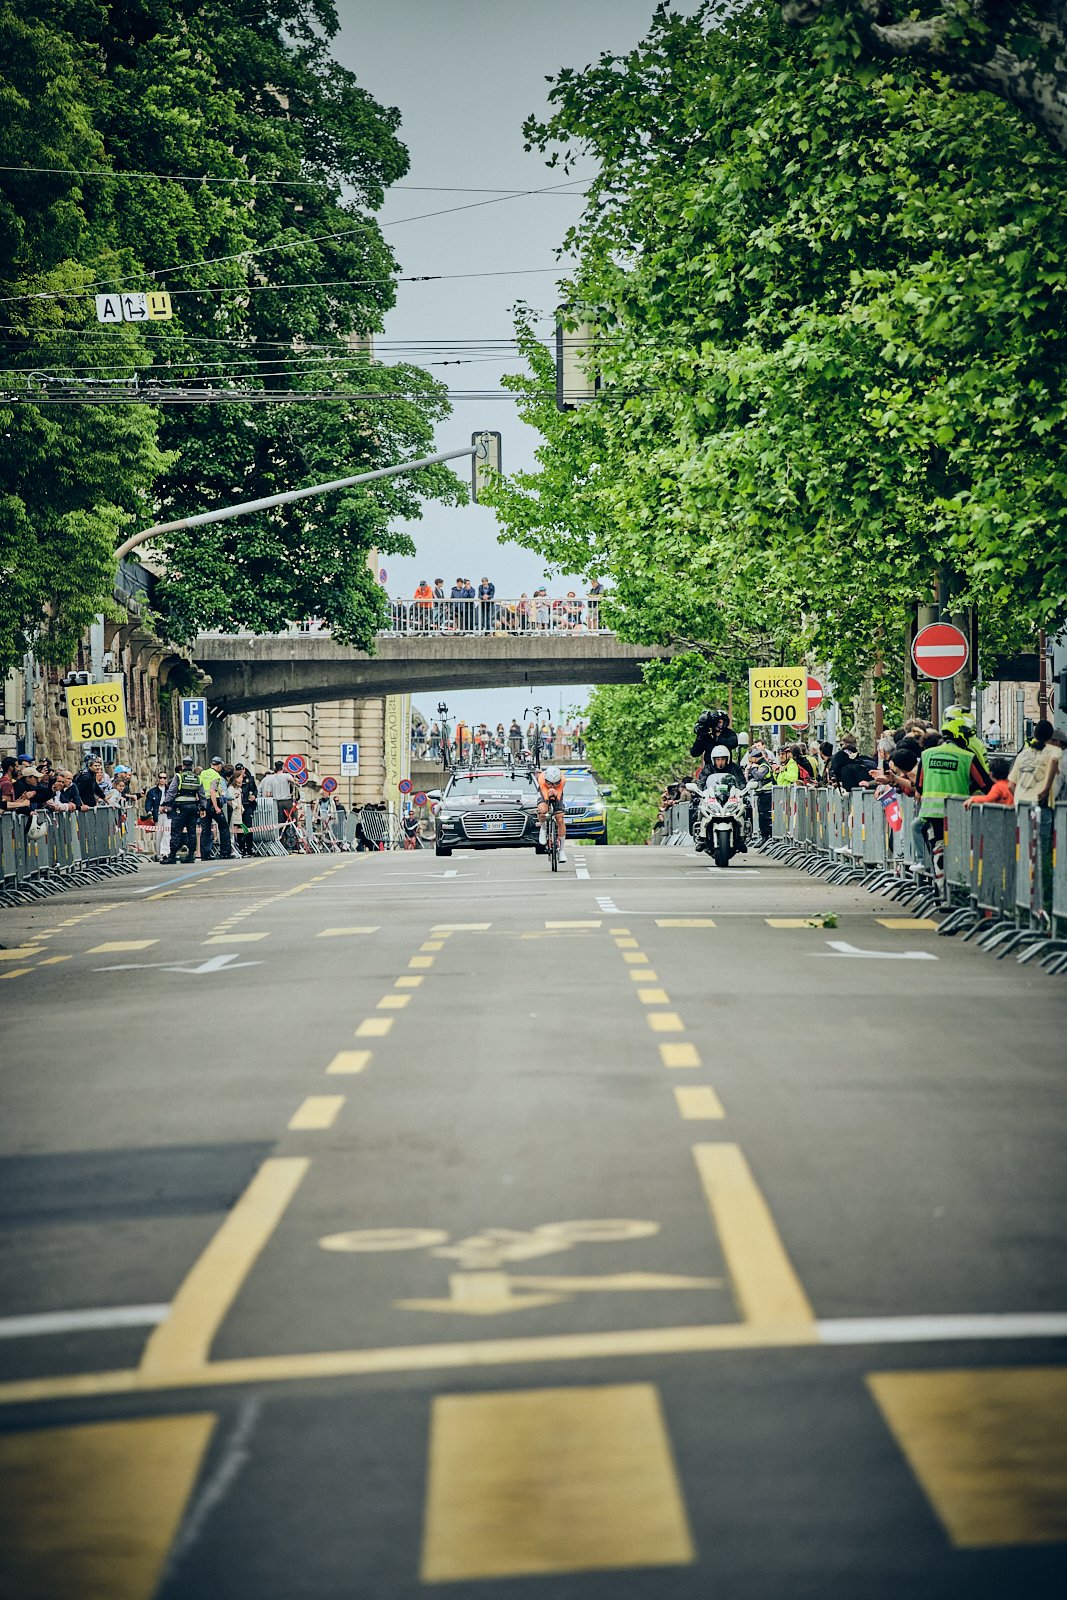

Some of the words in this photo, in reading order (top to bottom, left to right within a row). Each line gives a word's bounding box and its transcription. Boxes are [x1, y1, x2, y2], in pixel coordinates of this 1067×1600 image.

[104, 298, 116, 318] A
[754, 678, 803, 689] CHICCO
[71, 693, 120, 707] CHICCO
[759, 688, 800, 698] D'ORO
[77, 703, 117, 716] D'ORO
[189, 701, 199, 715] P
[761, 704, 797, 722] 500
[81, 720, 116, 739] 500
[346, 745, 354, 755] P
